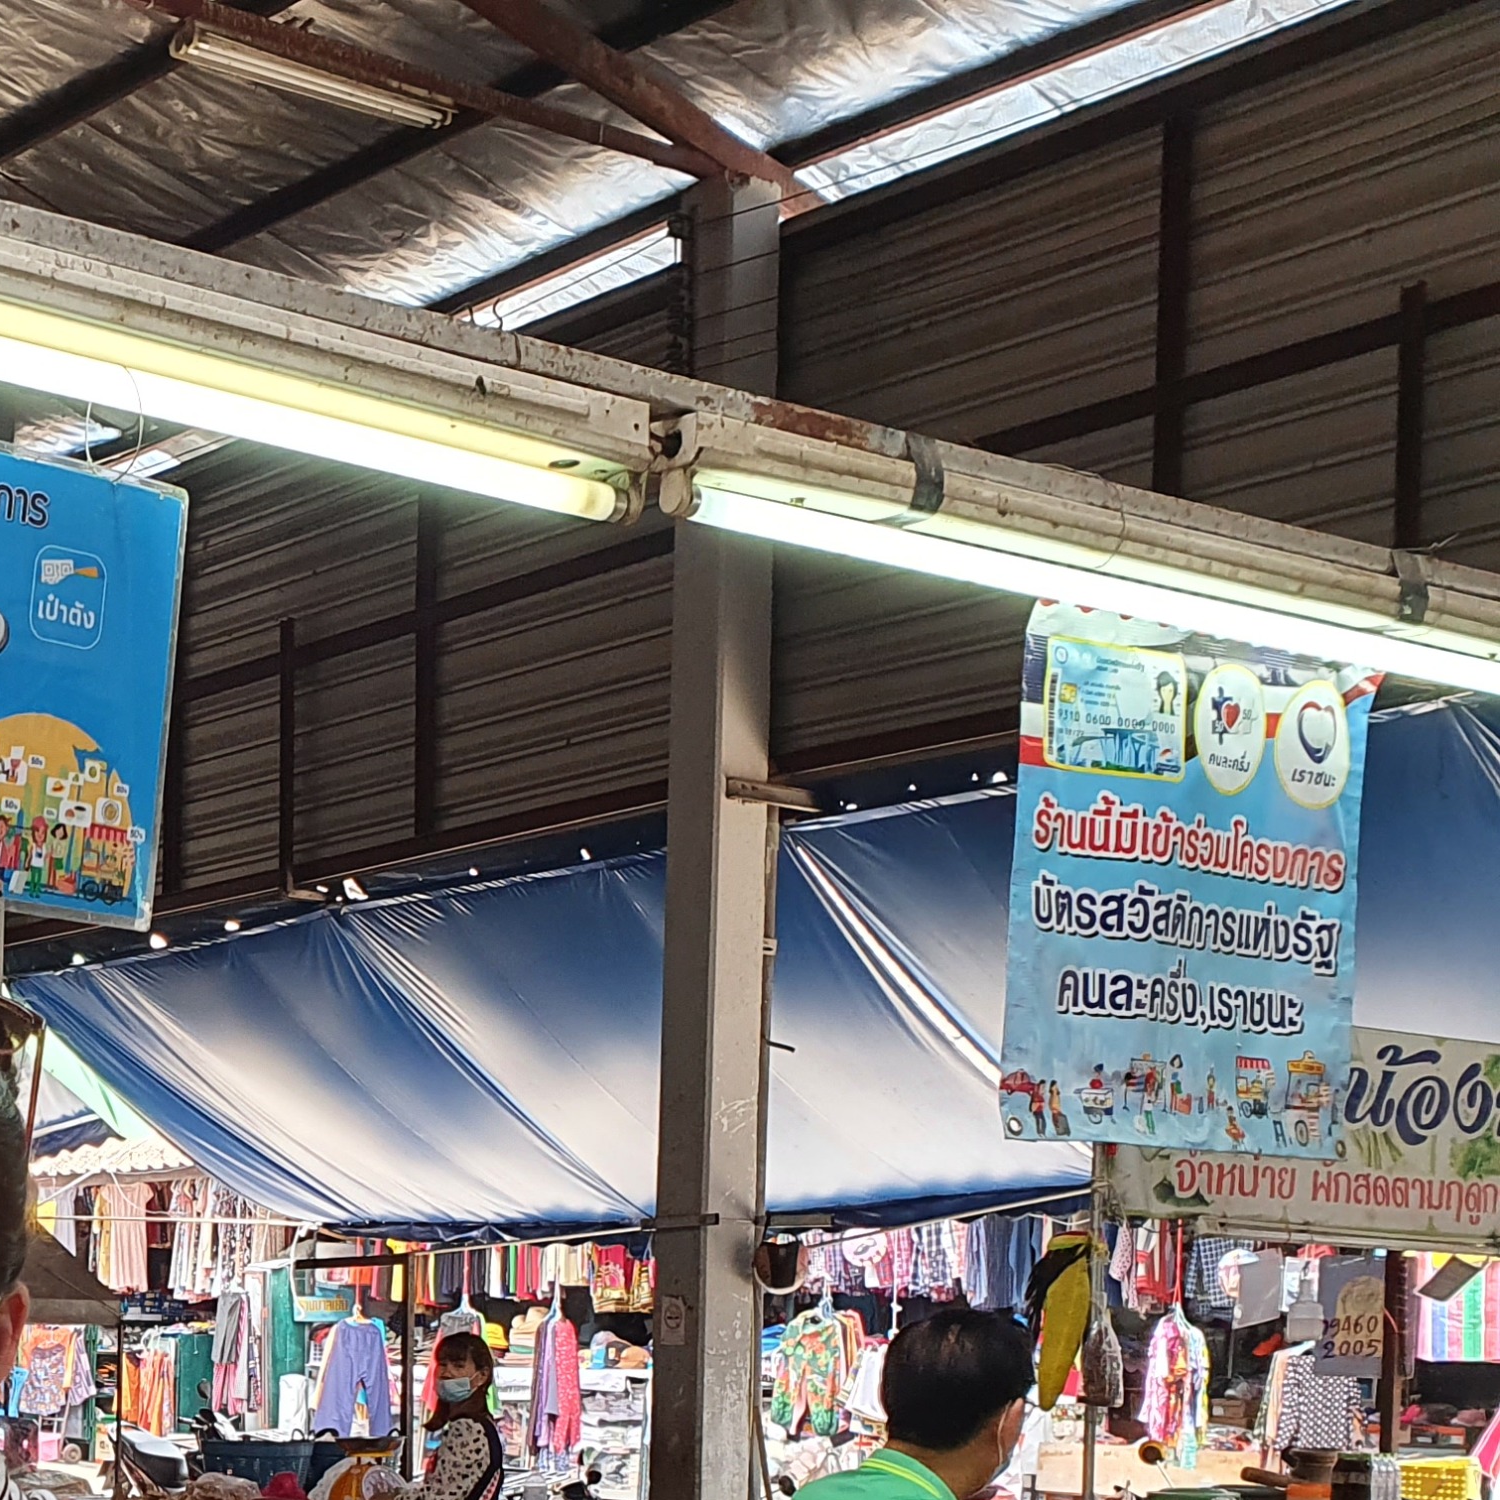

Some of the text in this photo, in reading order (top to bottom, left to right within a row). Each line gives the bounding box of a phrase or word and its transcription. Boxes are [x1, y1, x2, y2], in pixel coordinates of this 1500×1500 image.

[38, 594, 95, 630] เป๋าตัง
[1291, 768, 1336, 787] เราชนะ
[1034, 793, 1344, 887] ร้านนี้มีเข้าร่วมโครงการ
[1033, 874, 1337, 970] บัตรสวัสดิการแห่งรัฐ
[1344, 1044, 1500, 1146] น้อง
[1175, 1149, 1296, 1200] จำหน่าย
[1322, 1339, 1381, 1360] 2005
